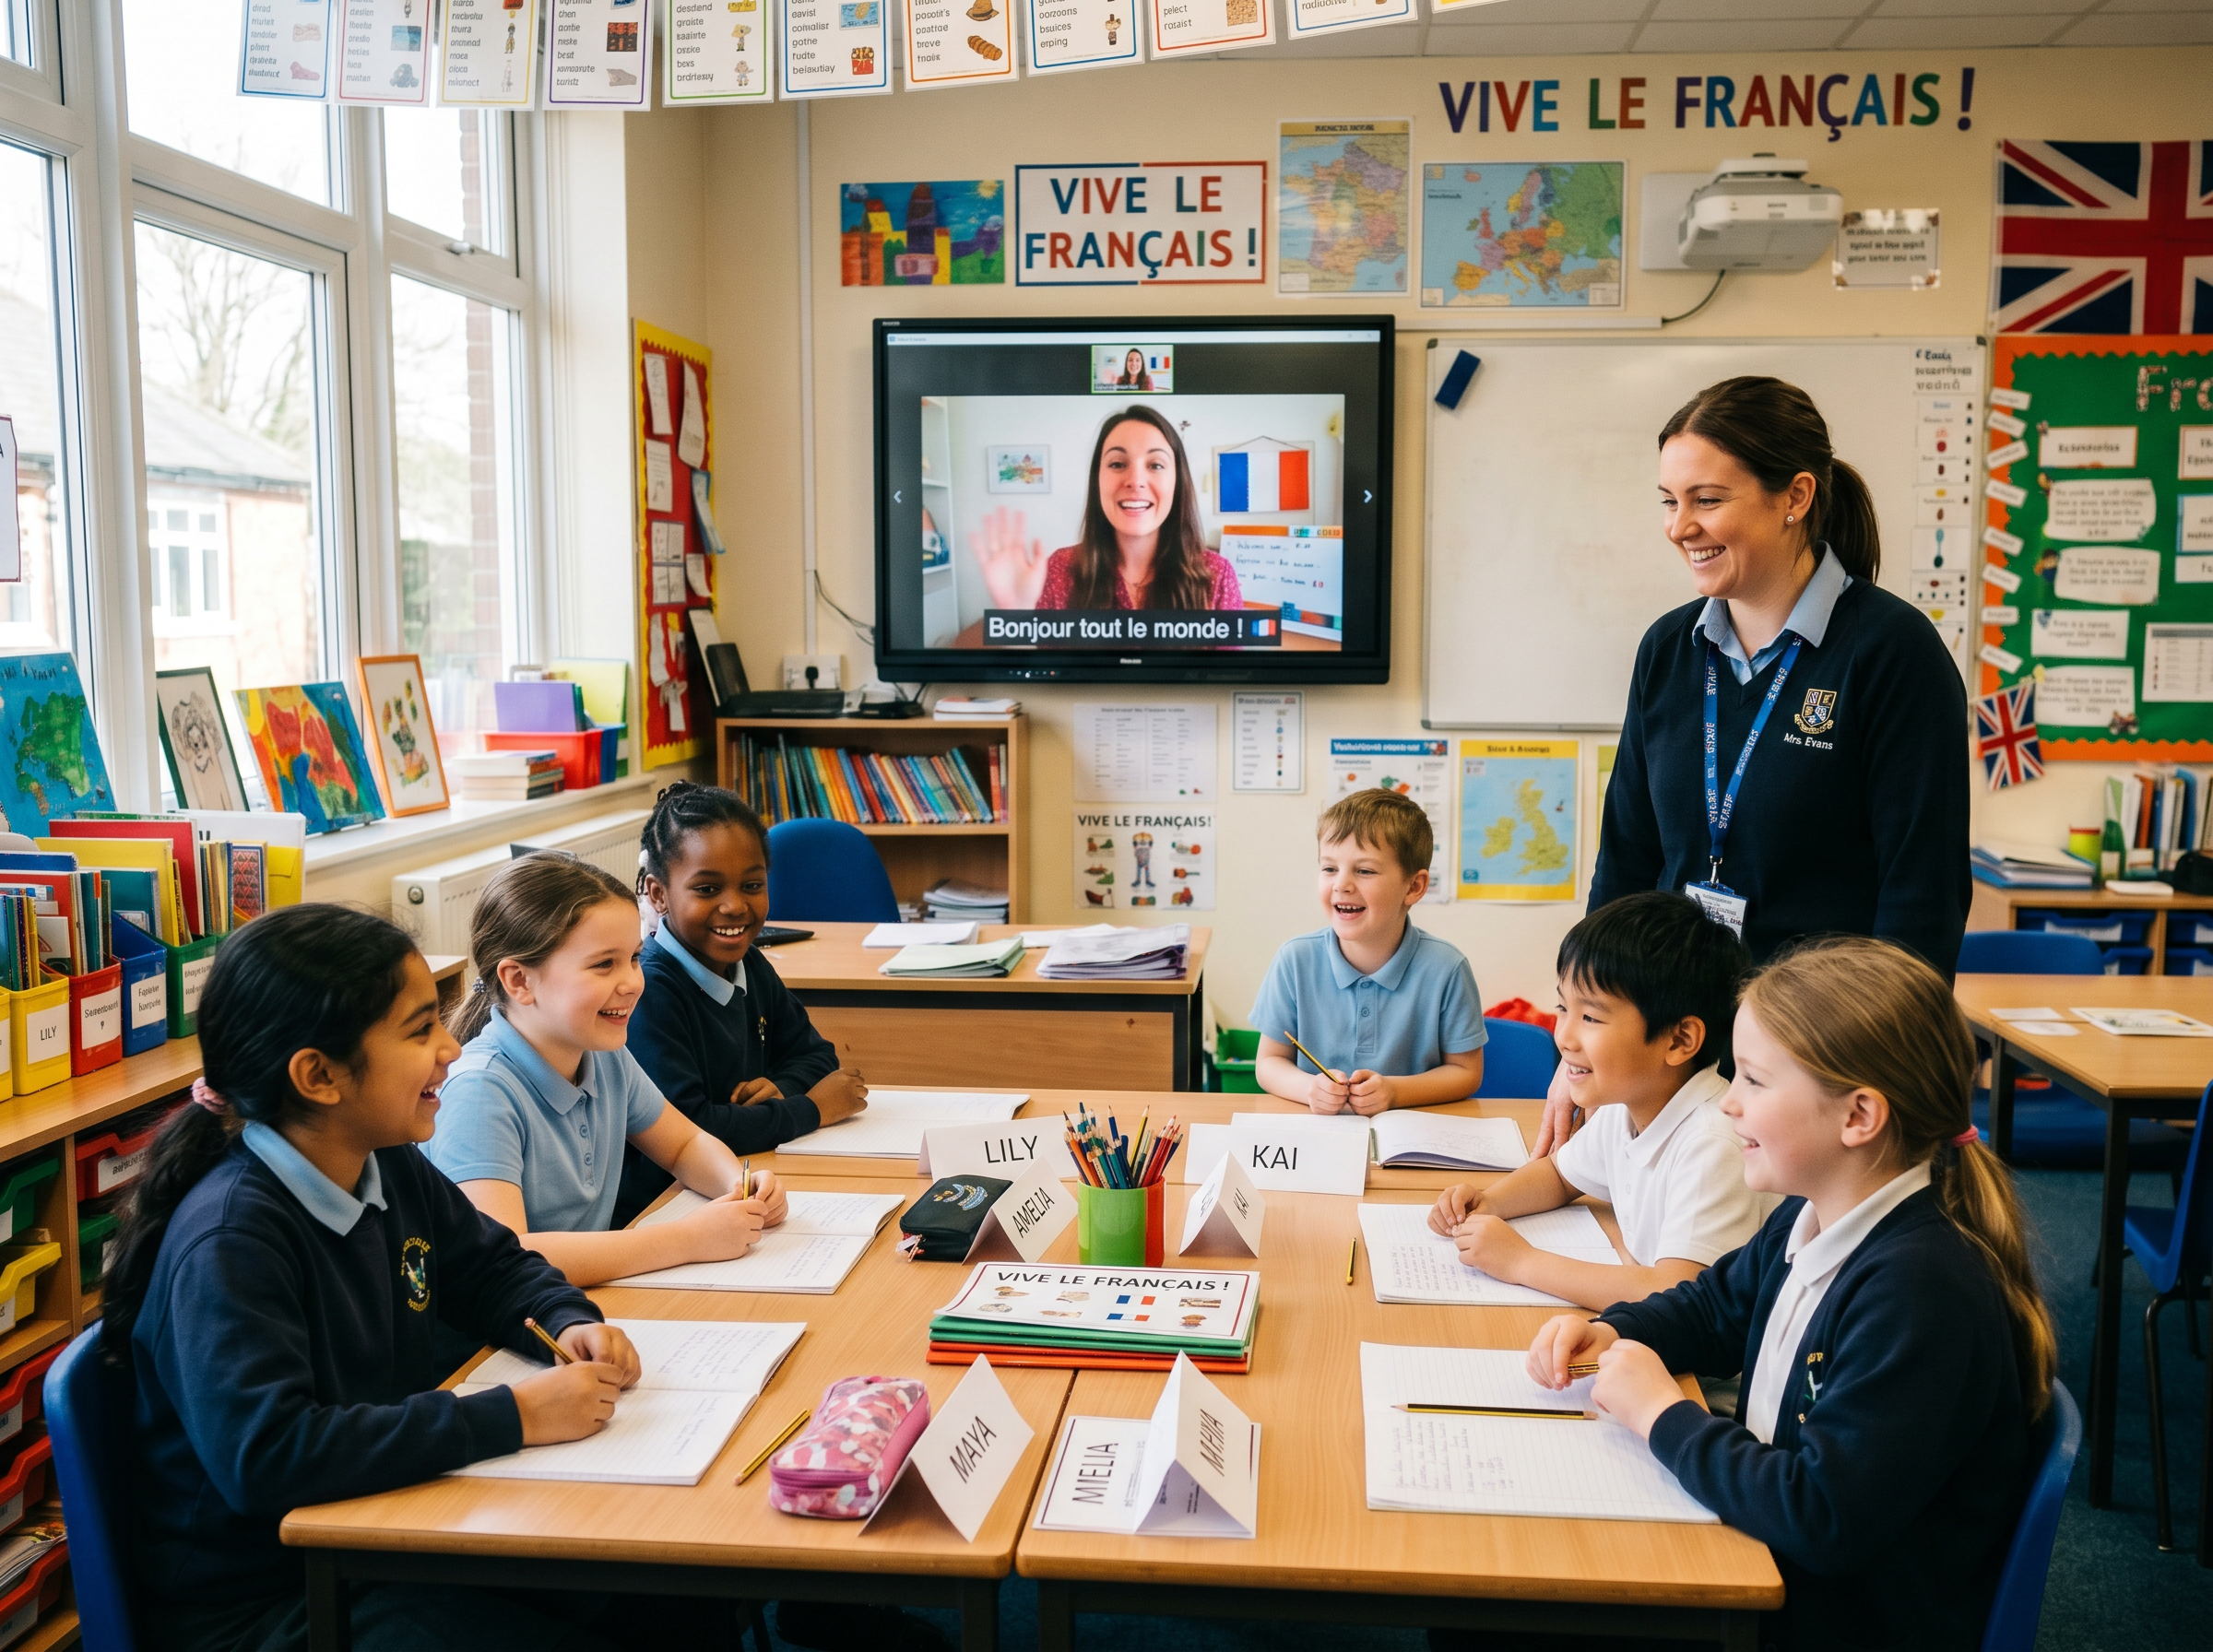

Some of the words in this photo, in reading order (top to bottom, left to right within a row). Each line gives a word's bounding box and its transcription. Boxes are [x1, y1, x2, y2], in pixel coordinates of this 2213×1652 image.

[1439, 80, 1559, 133] VIVE
[1589, 77, 1646, 129] LE
[1676, 73, 1940, 142] FRANÇAIS
[1958, 67, 1975, 131] !
[1050, 177, 1146, 214] VIVE
[1177, 176, 1222, 212] LE
[1026, 230, 1232, 278] FRANÇAIS
[1248, 229, 1256, 267] !
[989, 618, 1074, 643] Bonjour
[1080, 619, 1121, 638] tout
[1129, 618, 1147, 638] le
[1154, 618, 1229, 638] monde
[1237, 619, 1244, 638] !
[1805, 737, 1833, 749] Evans
[1078, 815, 1109, 827] VIVE
[1114, 815, 1130, 827] LE
[41, 1026, 56, 1041] LILY
[985, 1136, 1037, 1163] LILY
[1253, 1145, 1296, 1170] KAI
[1012, 1187, 1055, 1238] AMELIA
[998, 1272, 1051, 1282] VIVE
[1059, 1276, 1085, 1284] LE
[1094, 1277, 1215, 1291] FRANÇAIS
[1223, 1281, 1230, 1290] !
[950, 1416, 997, 1483] MAYA
